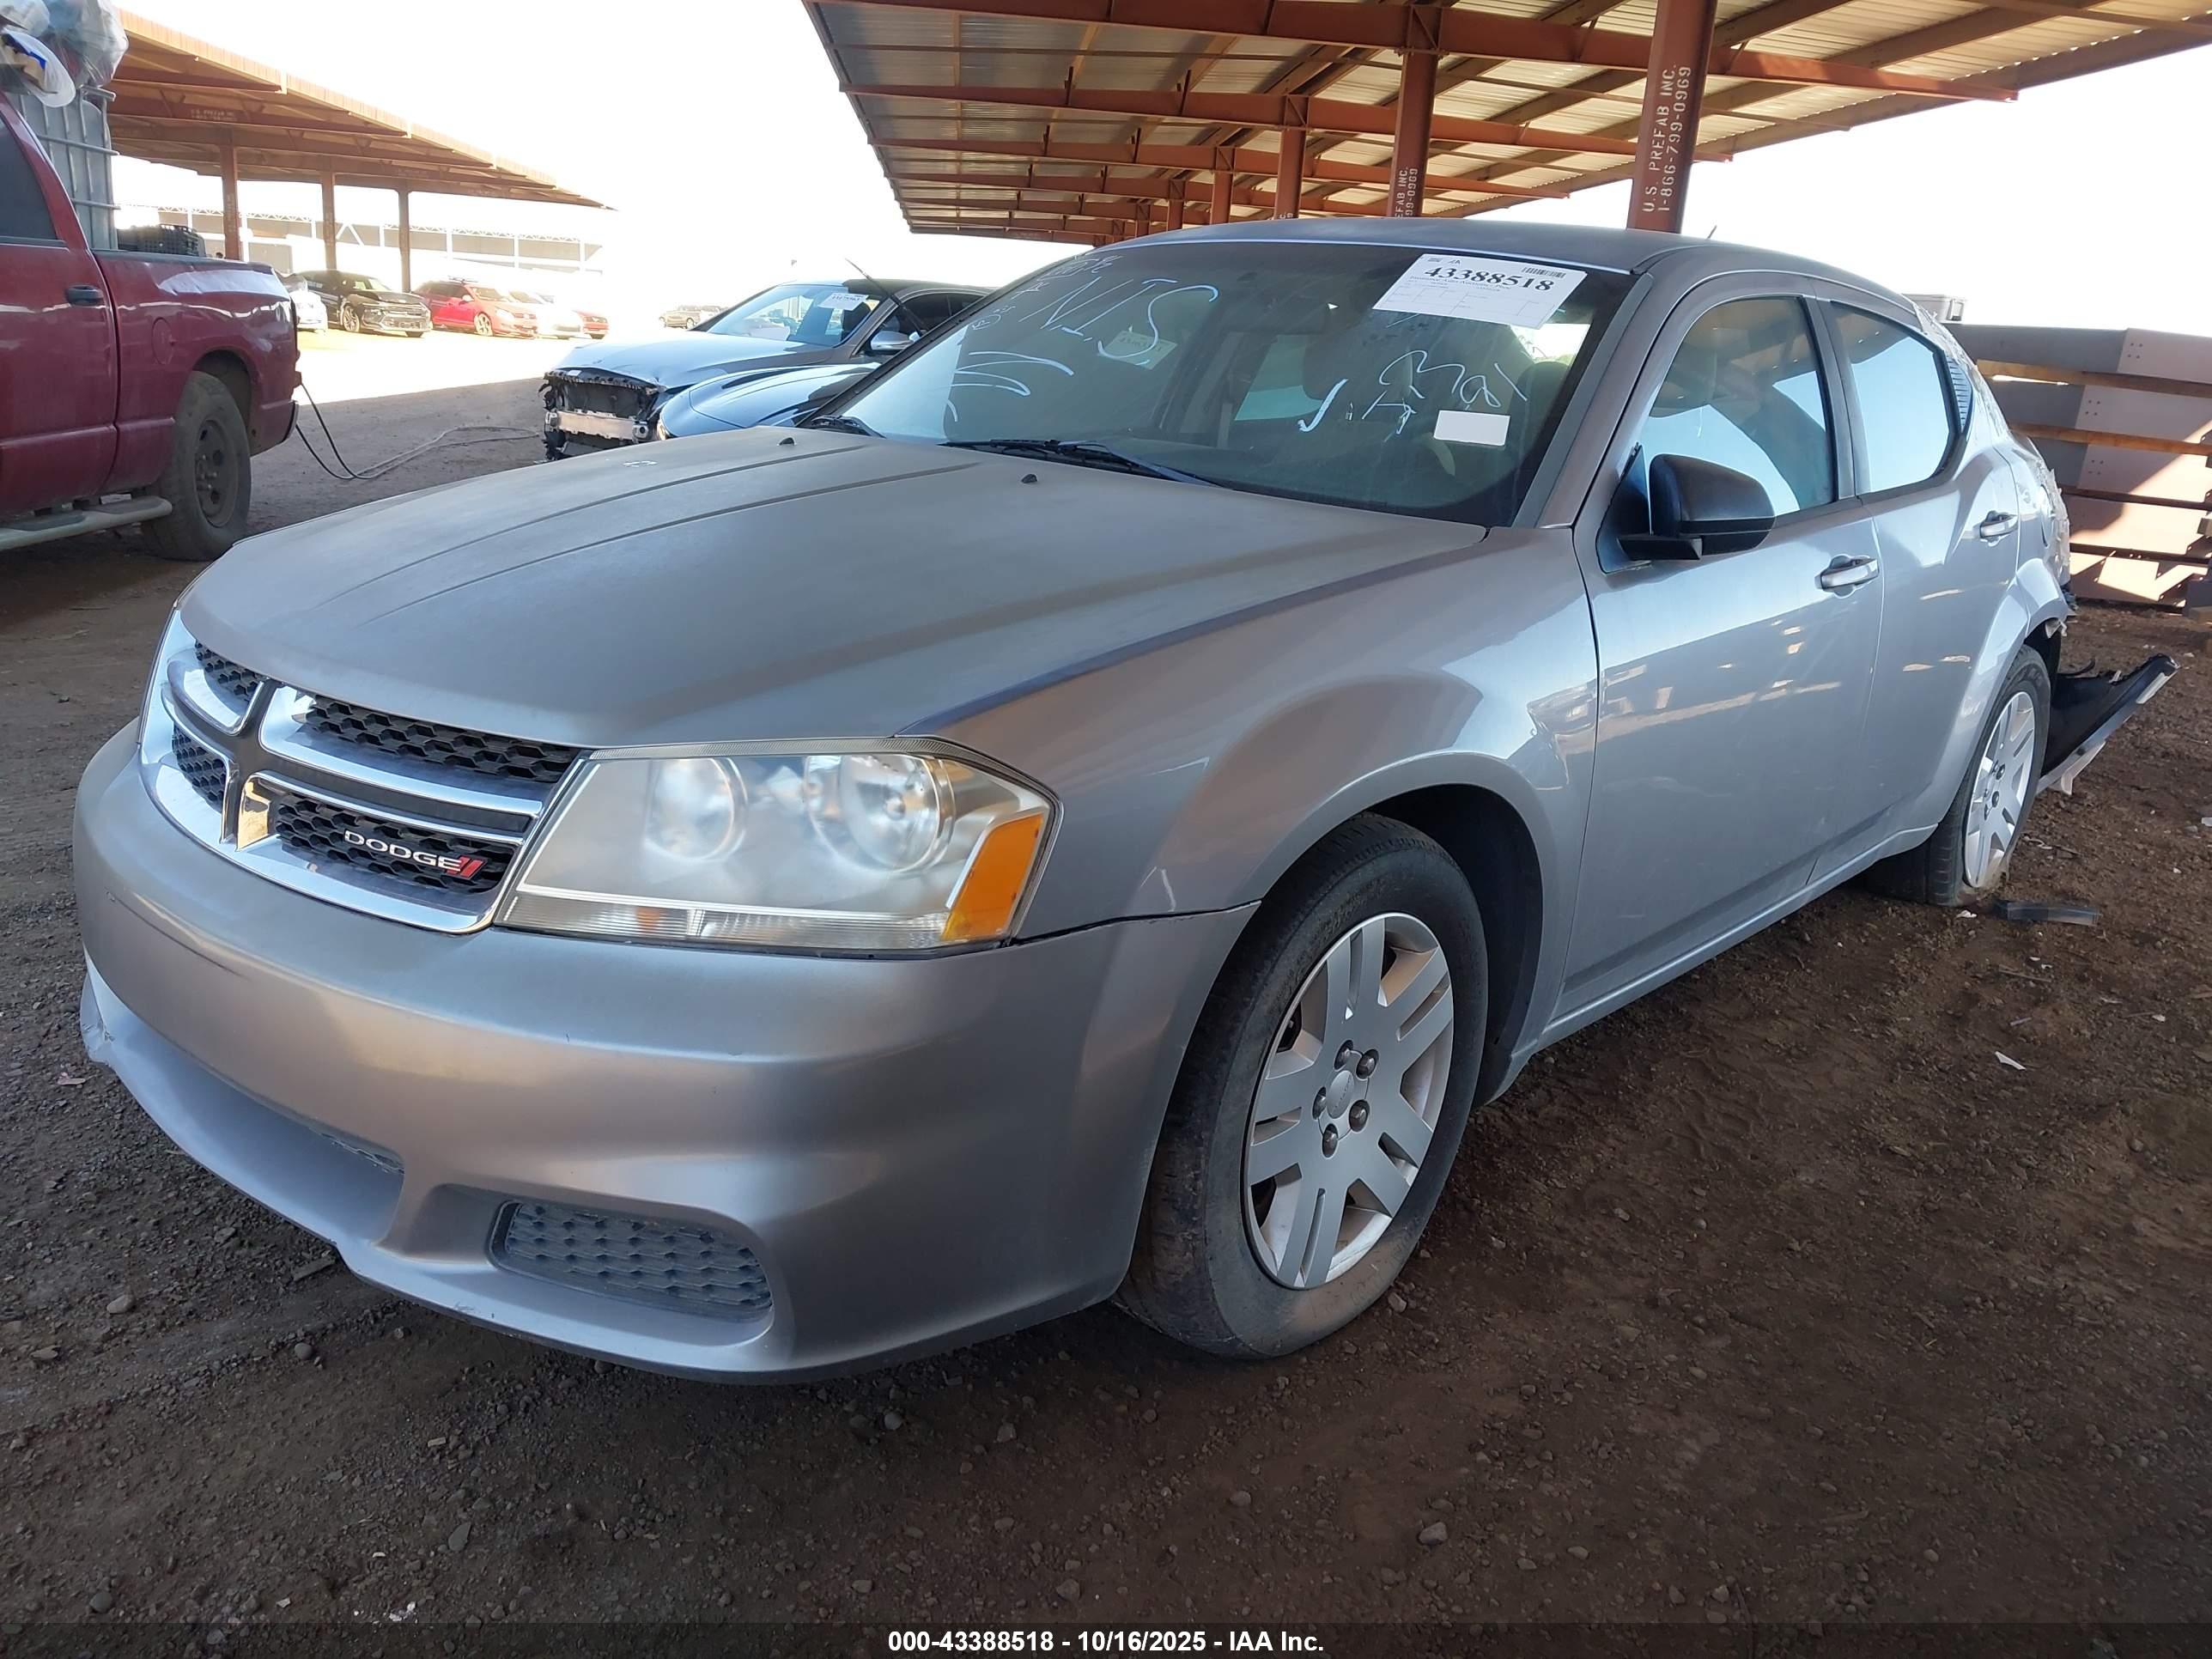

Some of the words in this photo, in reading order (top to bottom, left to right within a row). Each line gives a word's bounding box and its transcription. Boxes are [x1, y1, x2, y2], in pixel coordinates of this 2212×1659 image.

[1649, 106, 1669, 171] PREFAB
[1660, 64, 1677, 96] INC.
[1658, 66, 1691, 211] 1-866-799-0969
[1398, 167, 1408, 186] INC.
[1425, 267, 1554, 290] 43388518
[344, 830, 462, 872] DODGE
